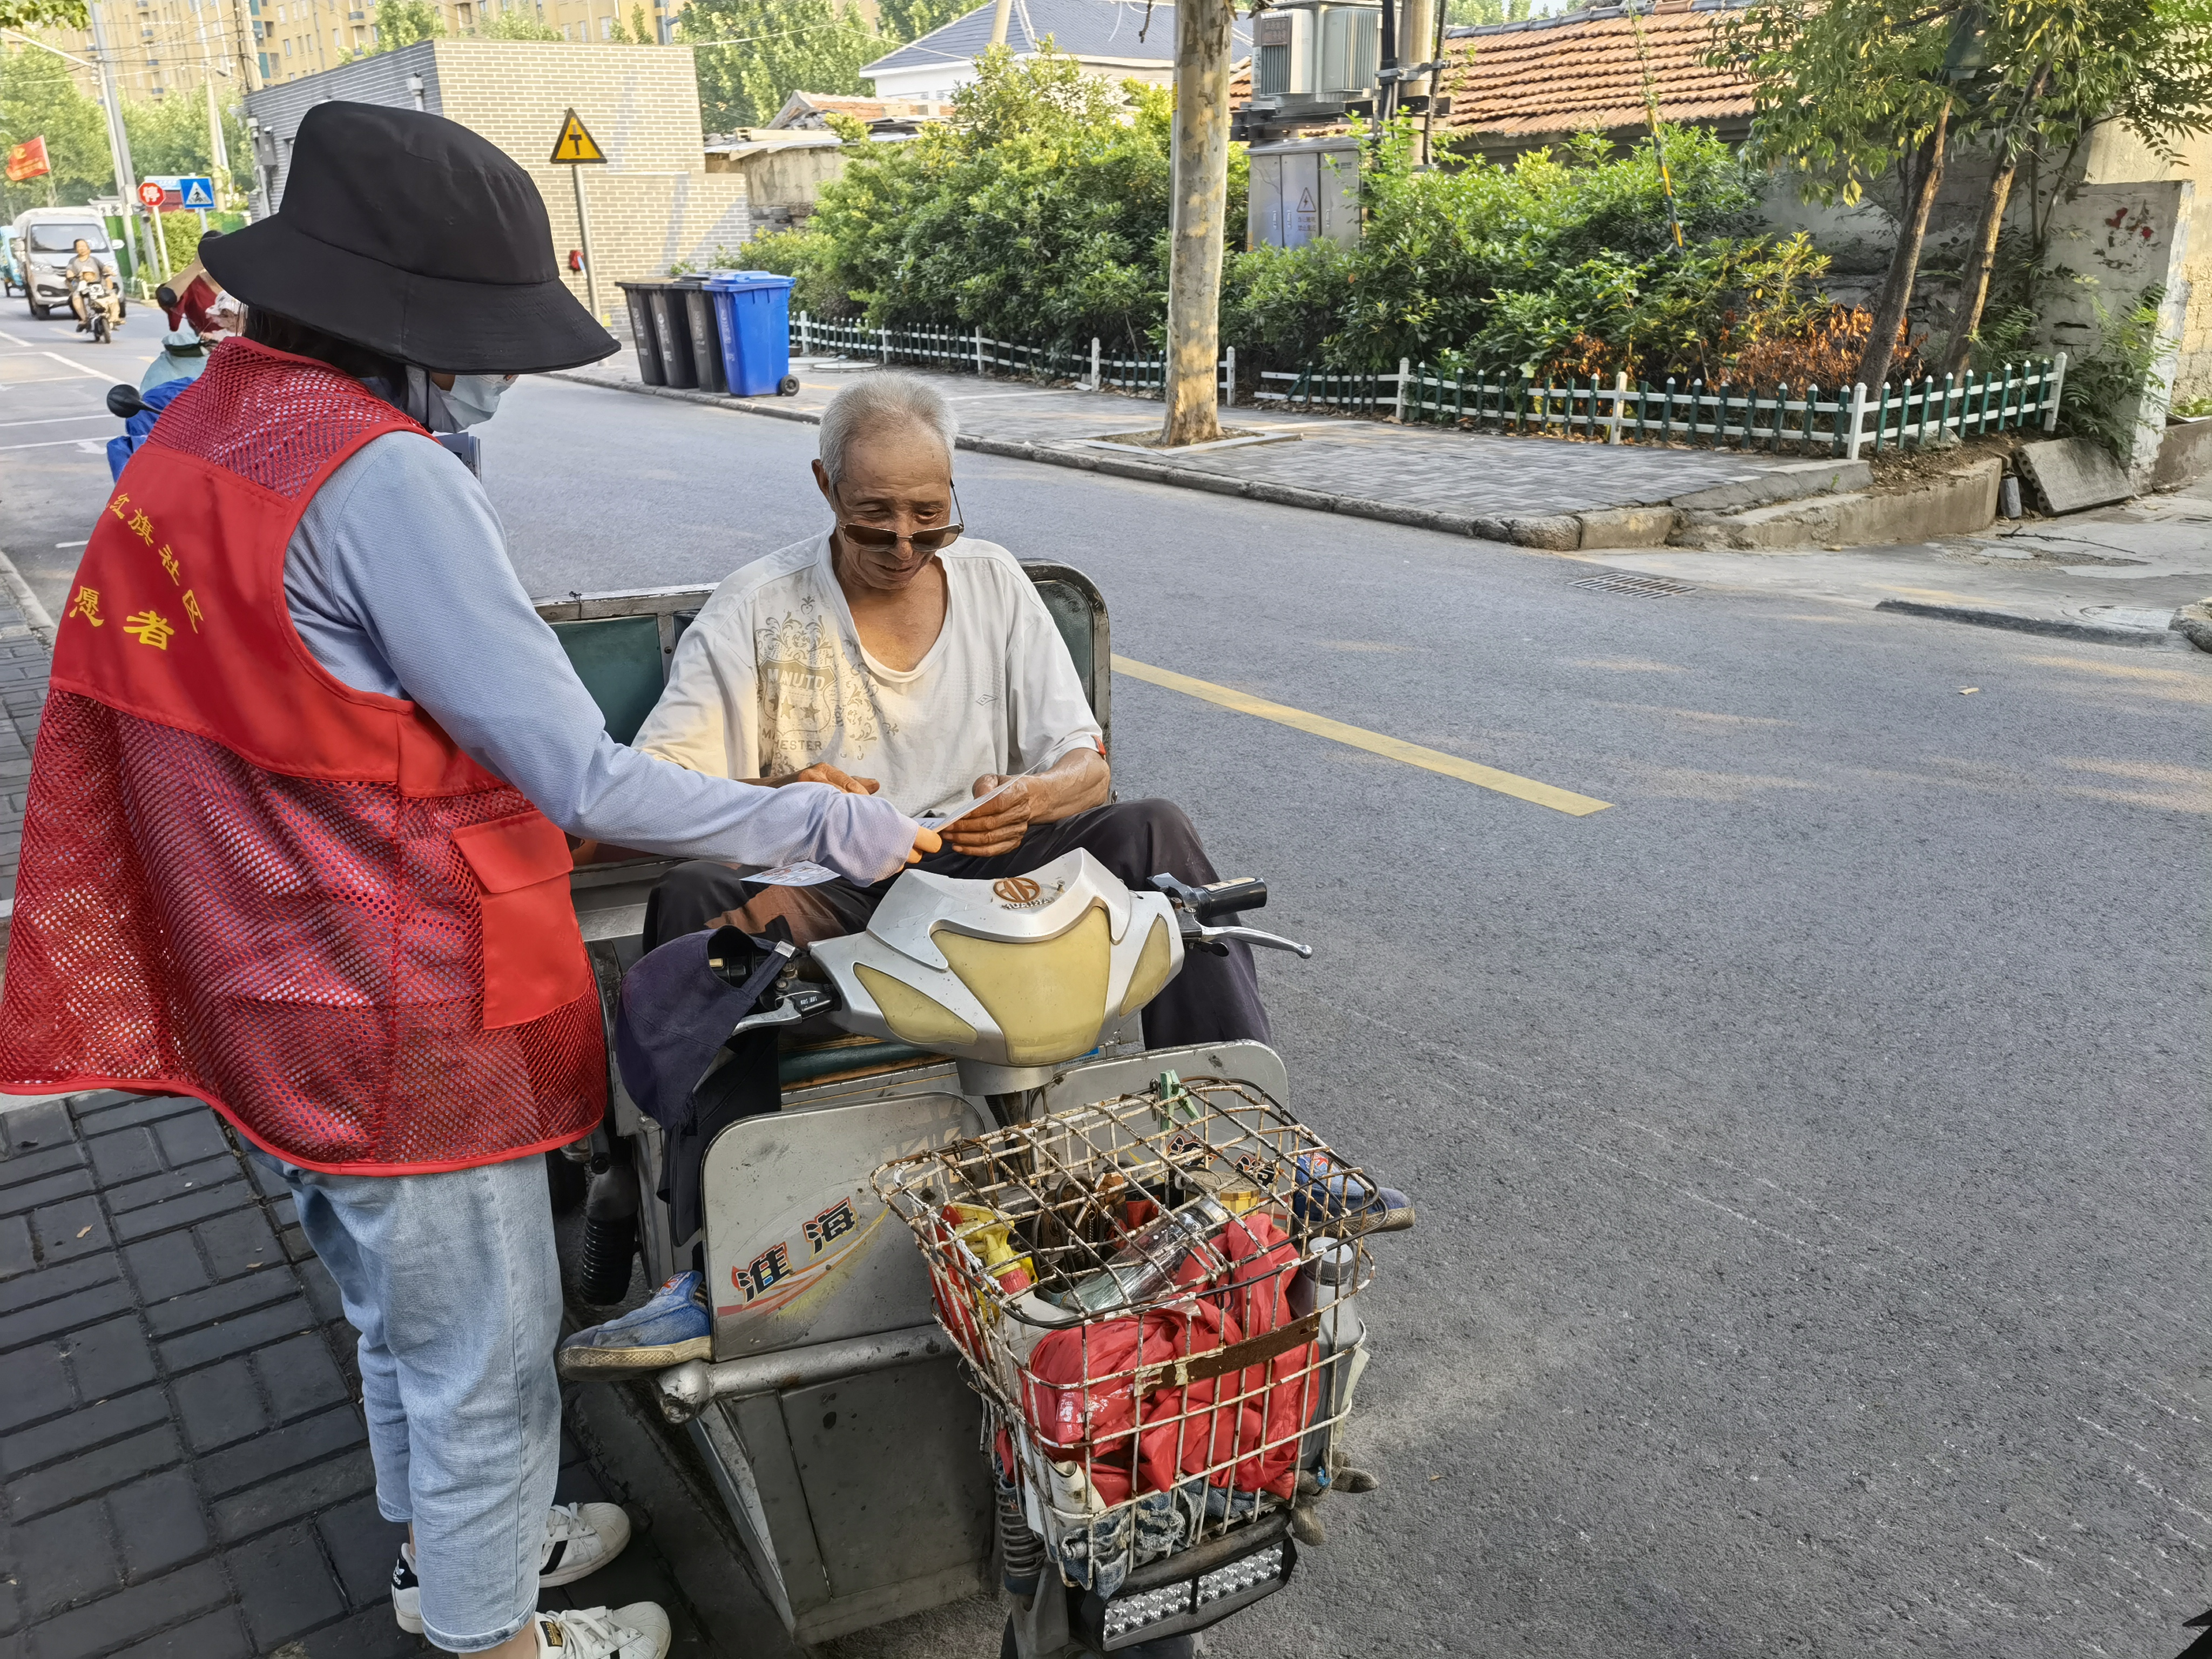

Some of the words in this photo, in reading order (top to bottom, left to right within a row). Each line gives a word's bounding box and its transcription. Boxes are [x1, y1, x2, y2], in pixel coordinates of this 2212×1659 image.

[69, 585, 175, 650] 愿者
[110, 493, 204, 634] 红旗社区
[733, 1197, 858, 1306] 淮海
